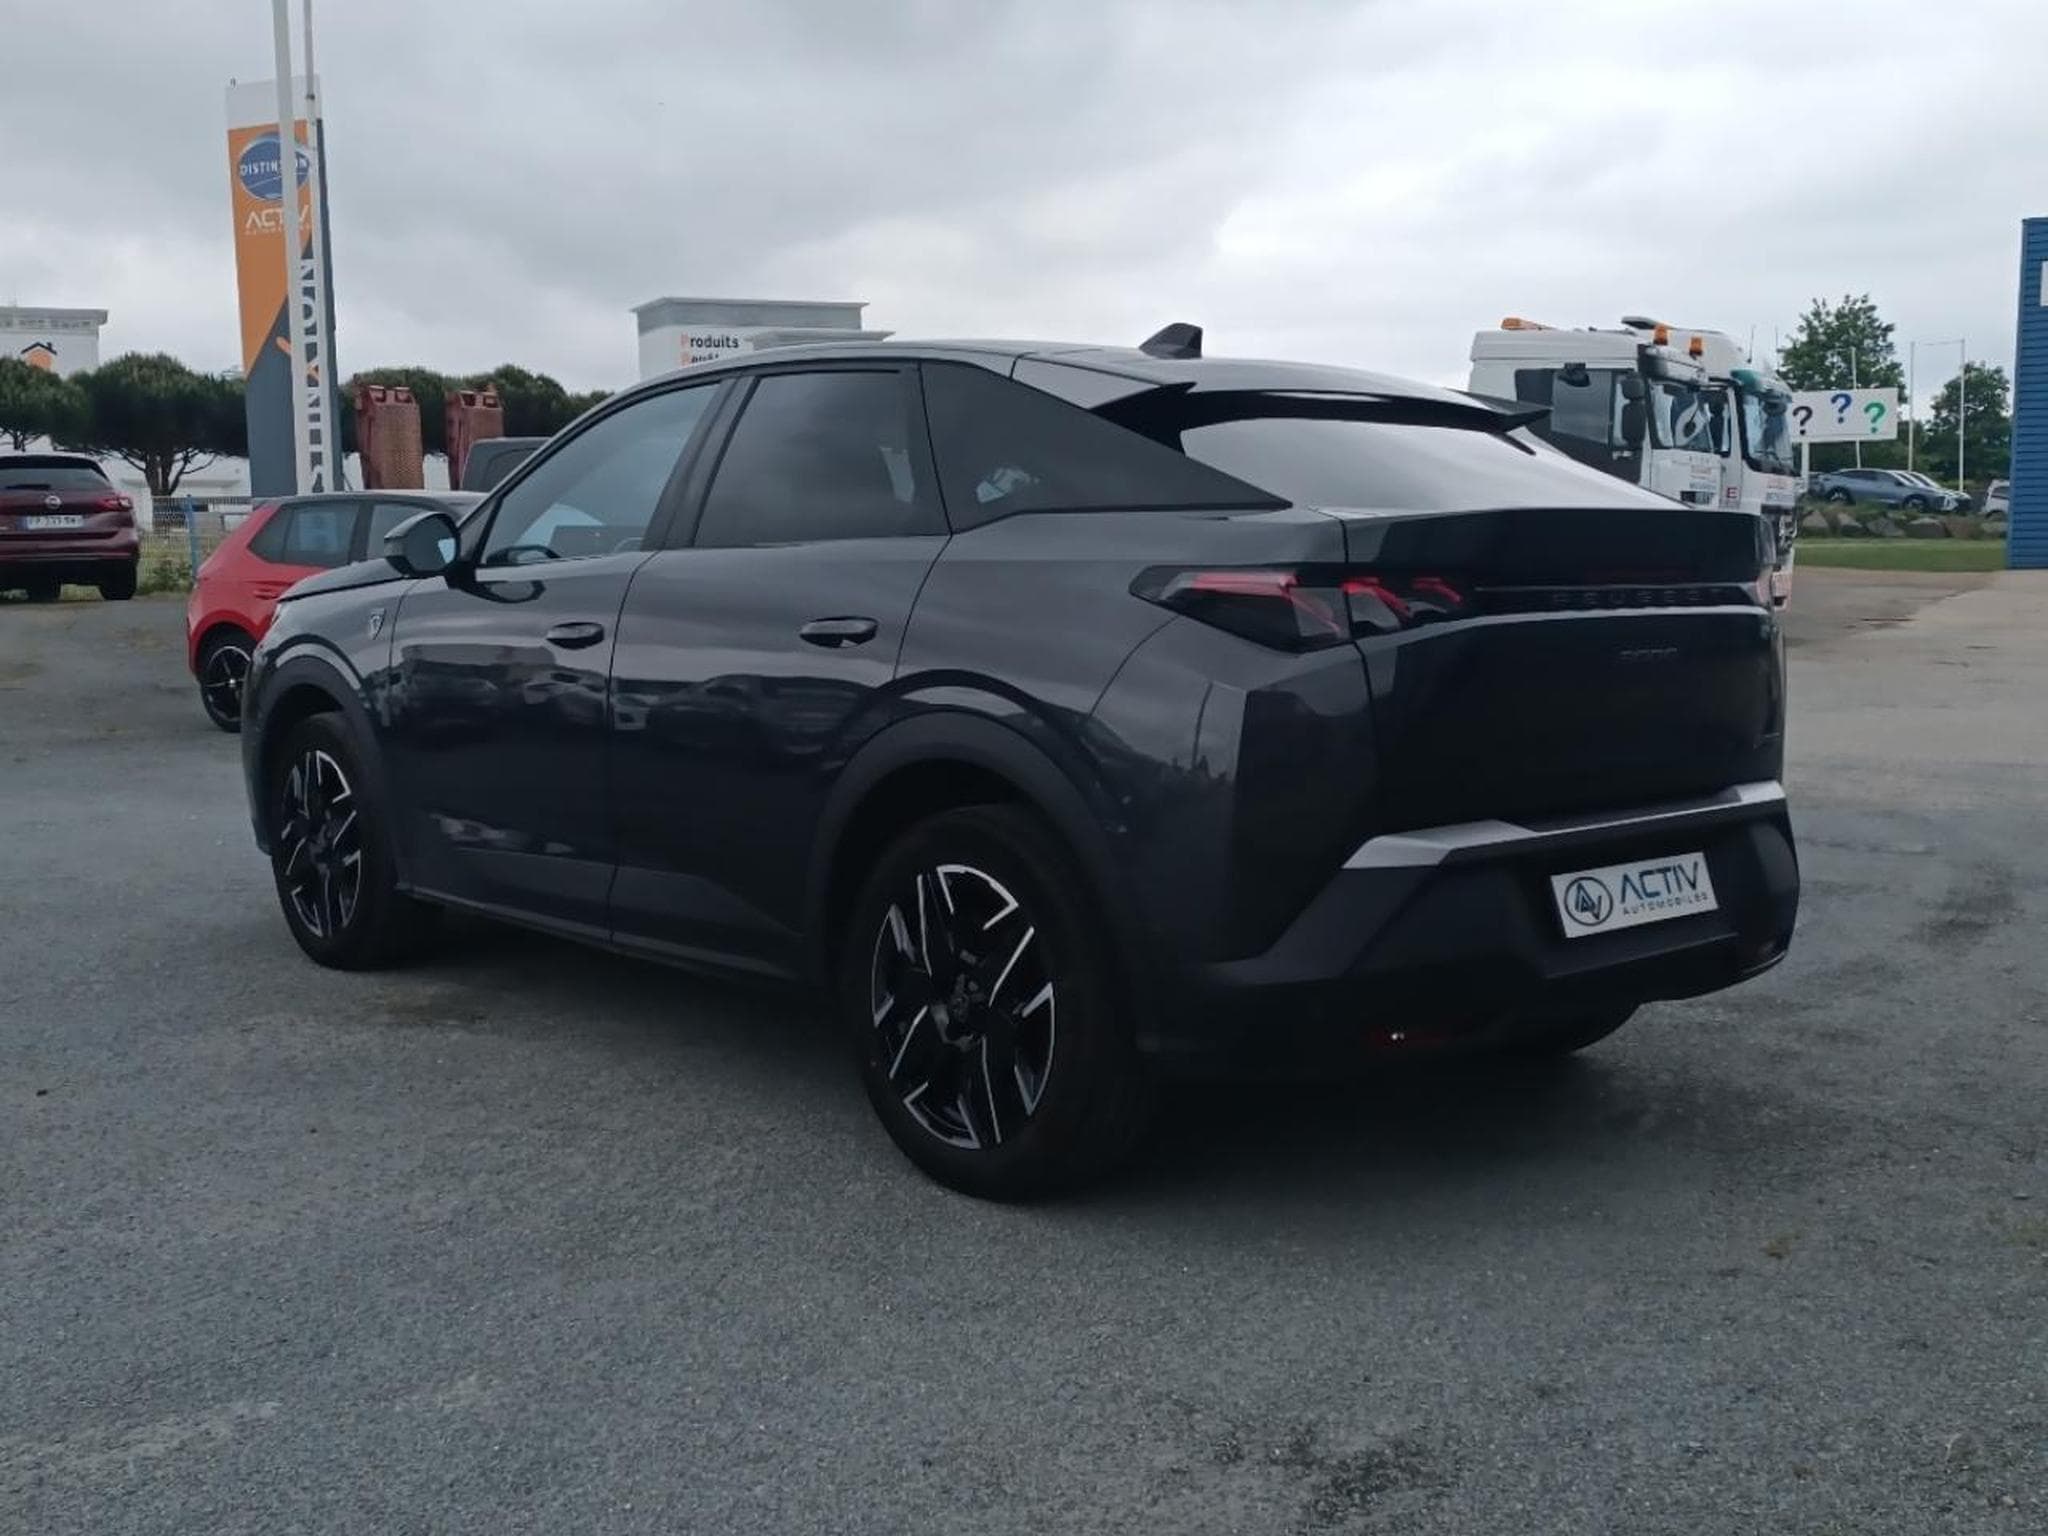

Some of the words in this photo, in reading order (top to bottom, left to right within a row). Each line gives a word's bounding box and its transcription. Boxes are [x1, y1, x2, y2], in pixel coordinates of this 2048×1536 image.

[240, 158, 307, 176] DISTINN
[246, 204, 309, 228] ACTV
[681, 334, 740, 348] Produits
[1620, 861, 1699, 904] ACTIV
[1623, 892, 1709, 916] AUTOMOBILES
